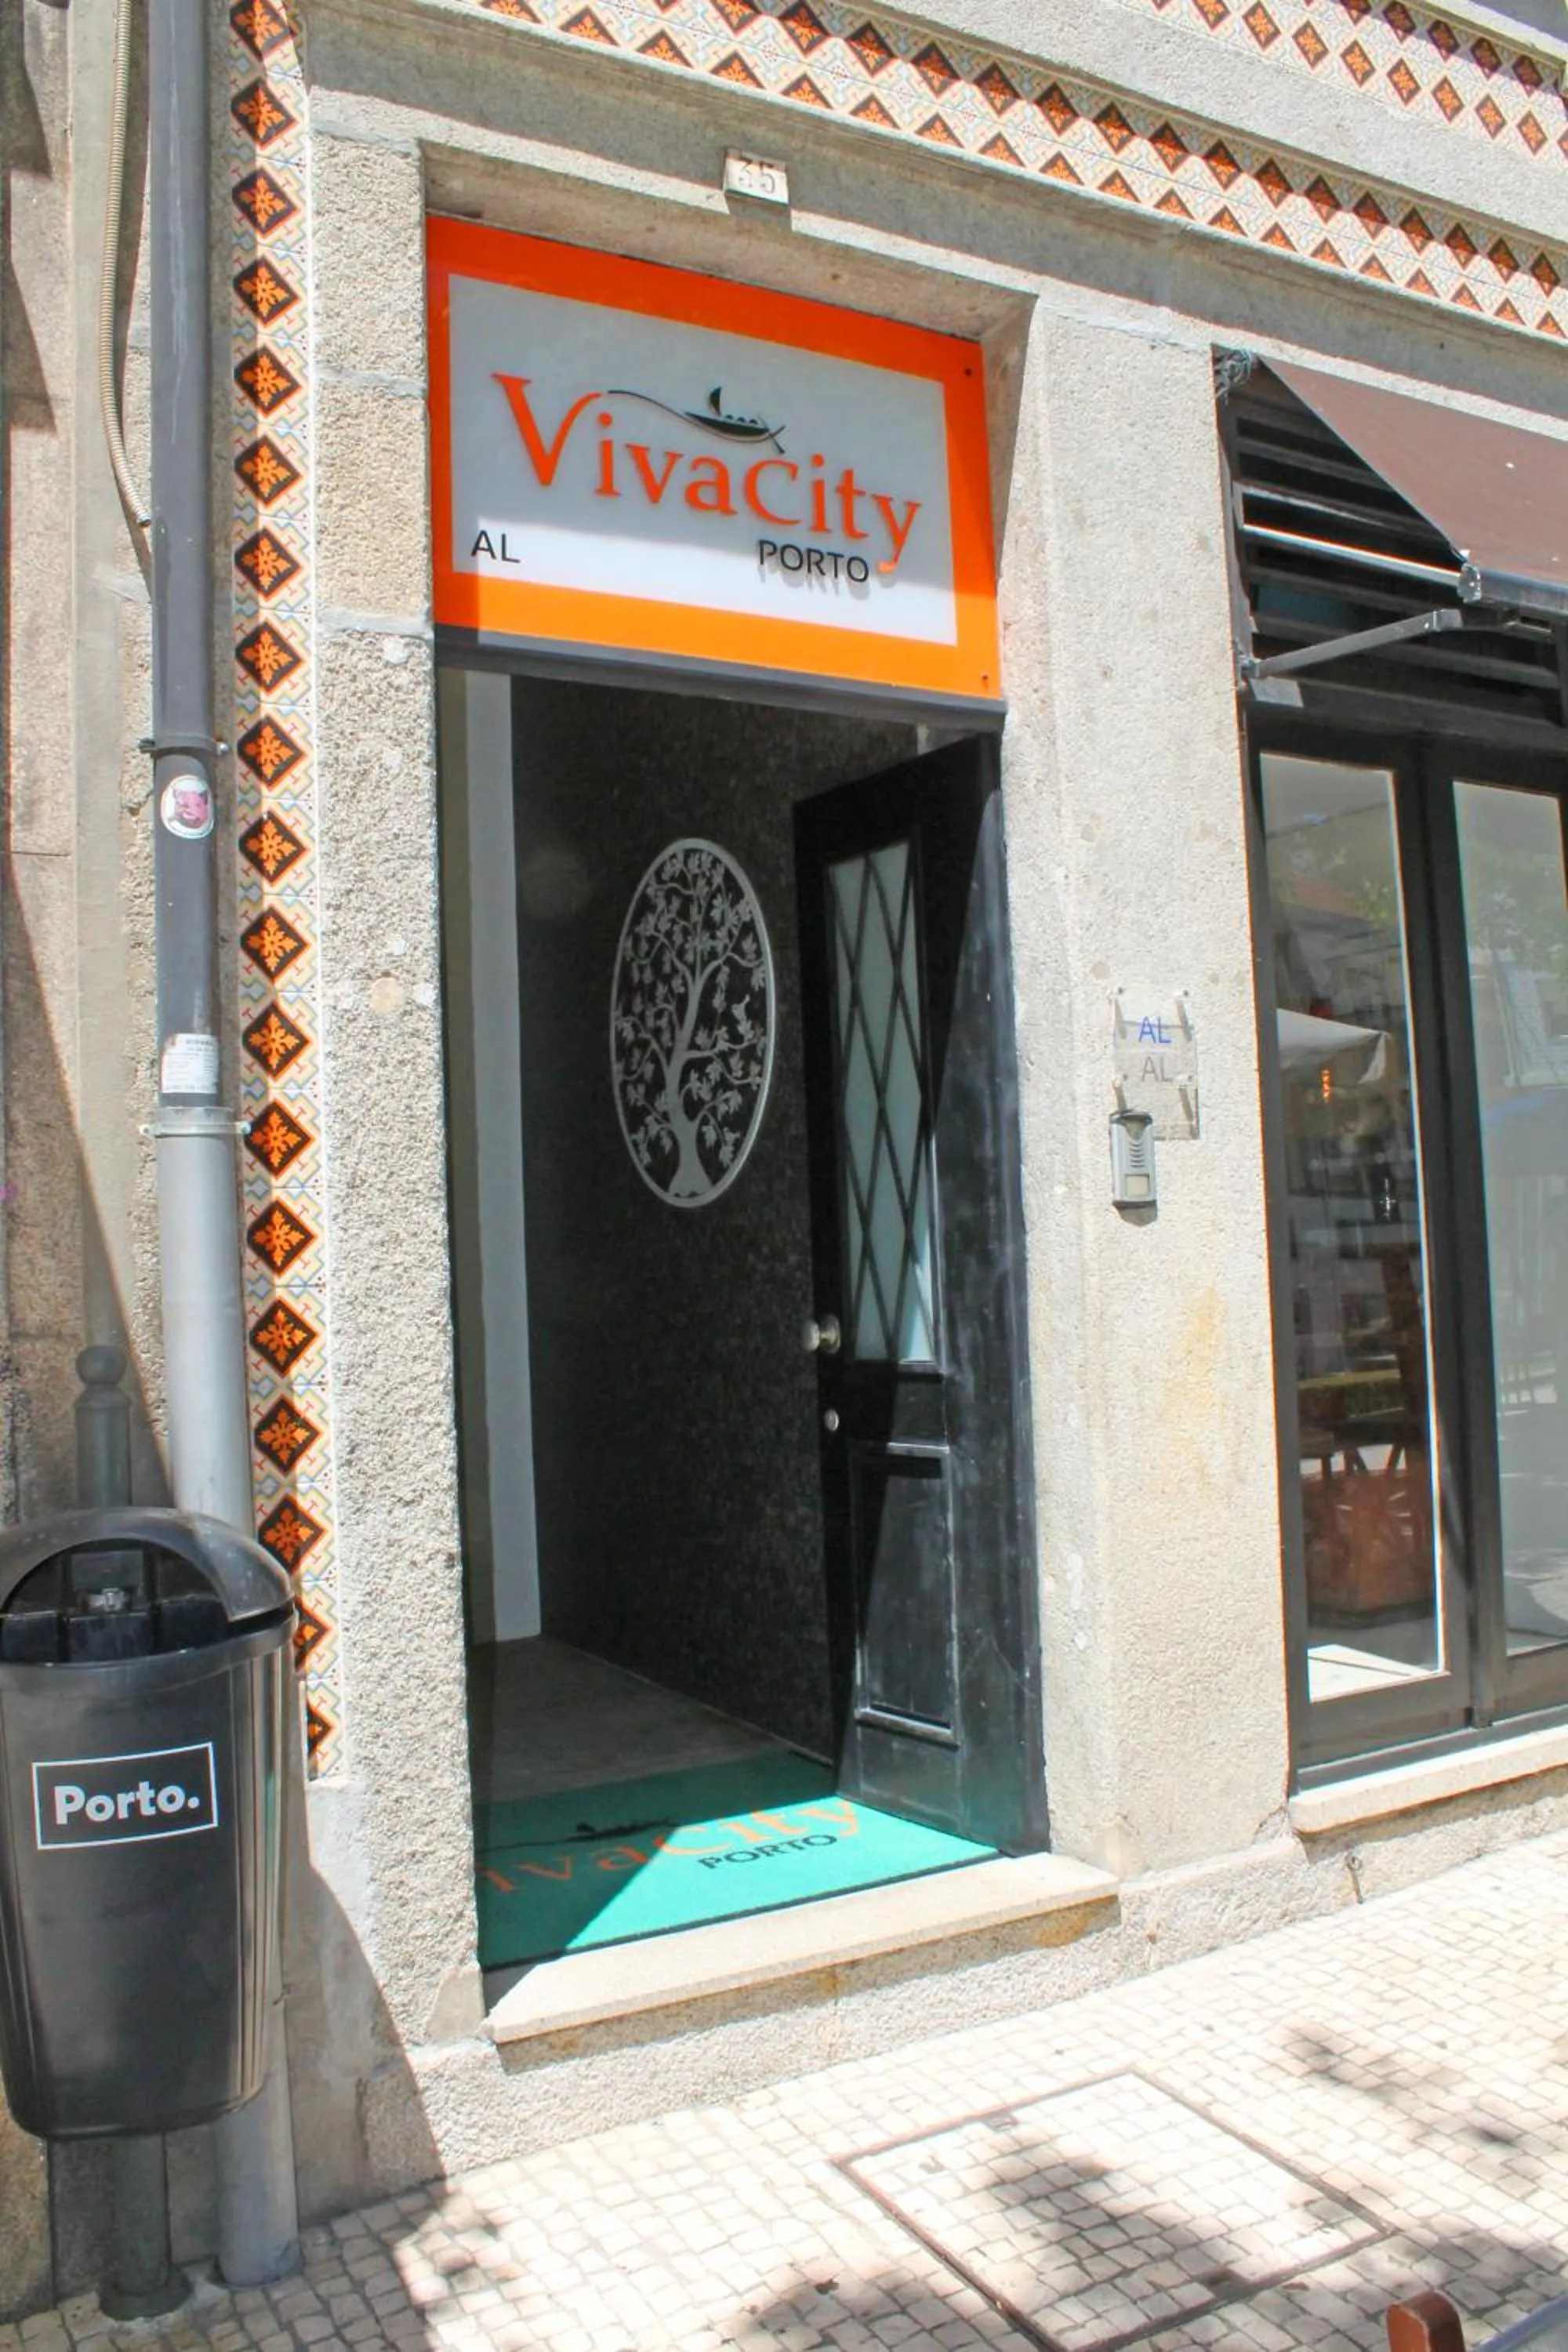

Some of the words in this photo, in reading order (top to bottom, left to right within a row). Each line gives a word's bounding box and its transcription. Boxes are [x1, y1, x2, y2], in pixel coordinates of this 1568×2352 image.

[491, 372, 923, 574] VivaCity
[470, 529, 521, 564] AL
[758, 539, 870, 584] PORTO
[1138, 1016, 1172, 1044] AL
[1142, 1056, 1174, 1083] AL
[54, 1780, 200, 1825] Porto.
[478, 1798, 860, 1893] ivaCity
[698, 1834, 838, 1870] PORTO
